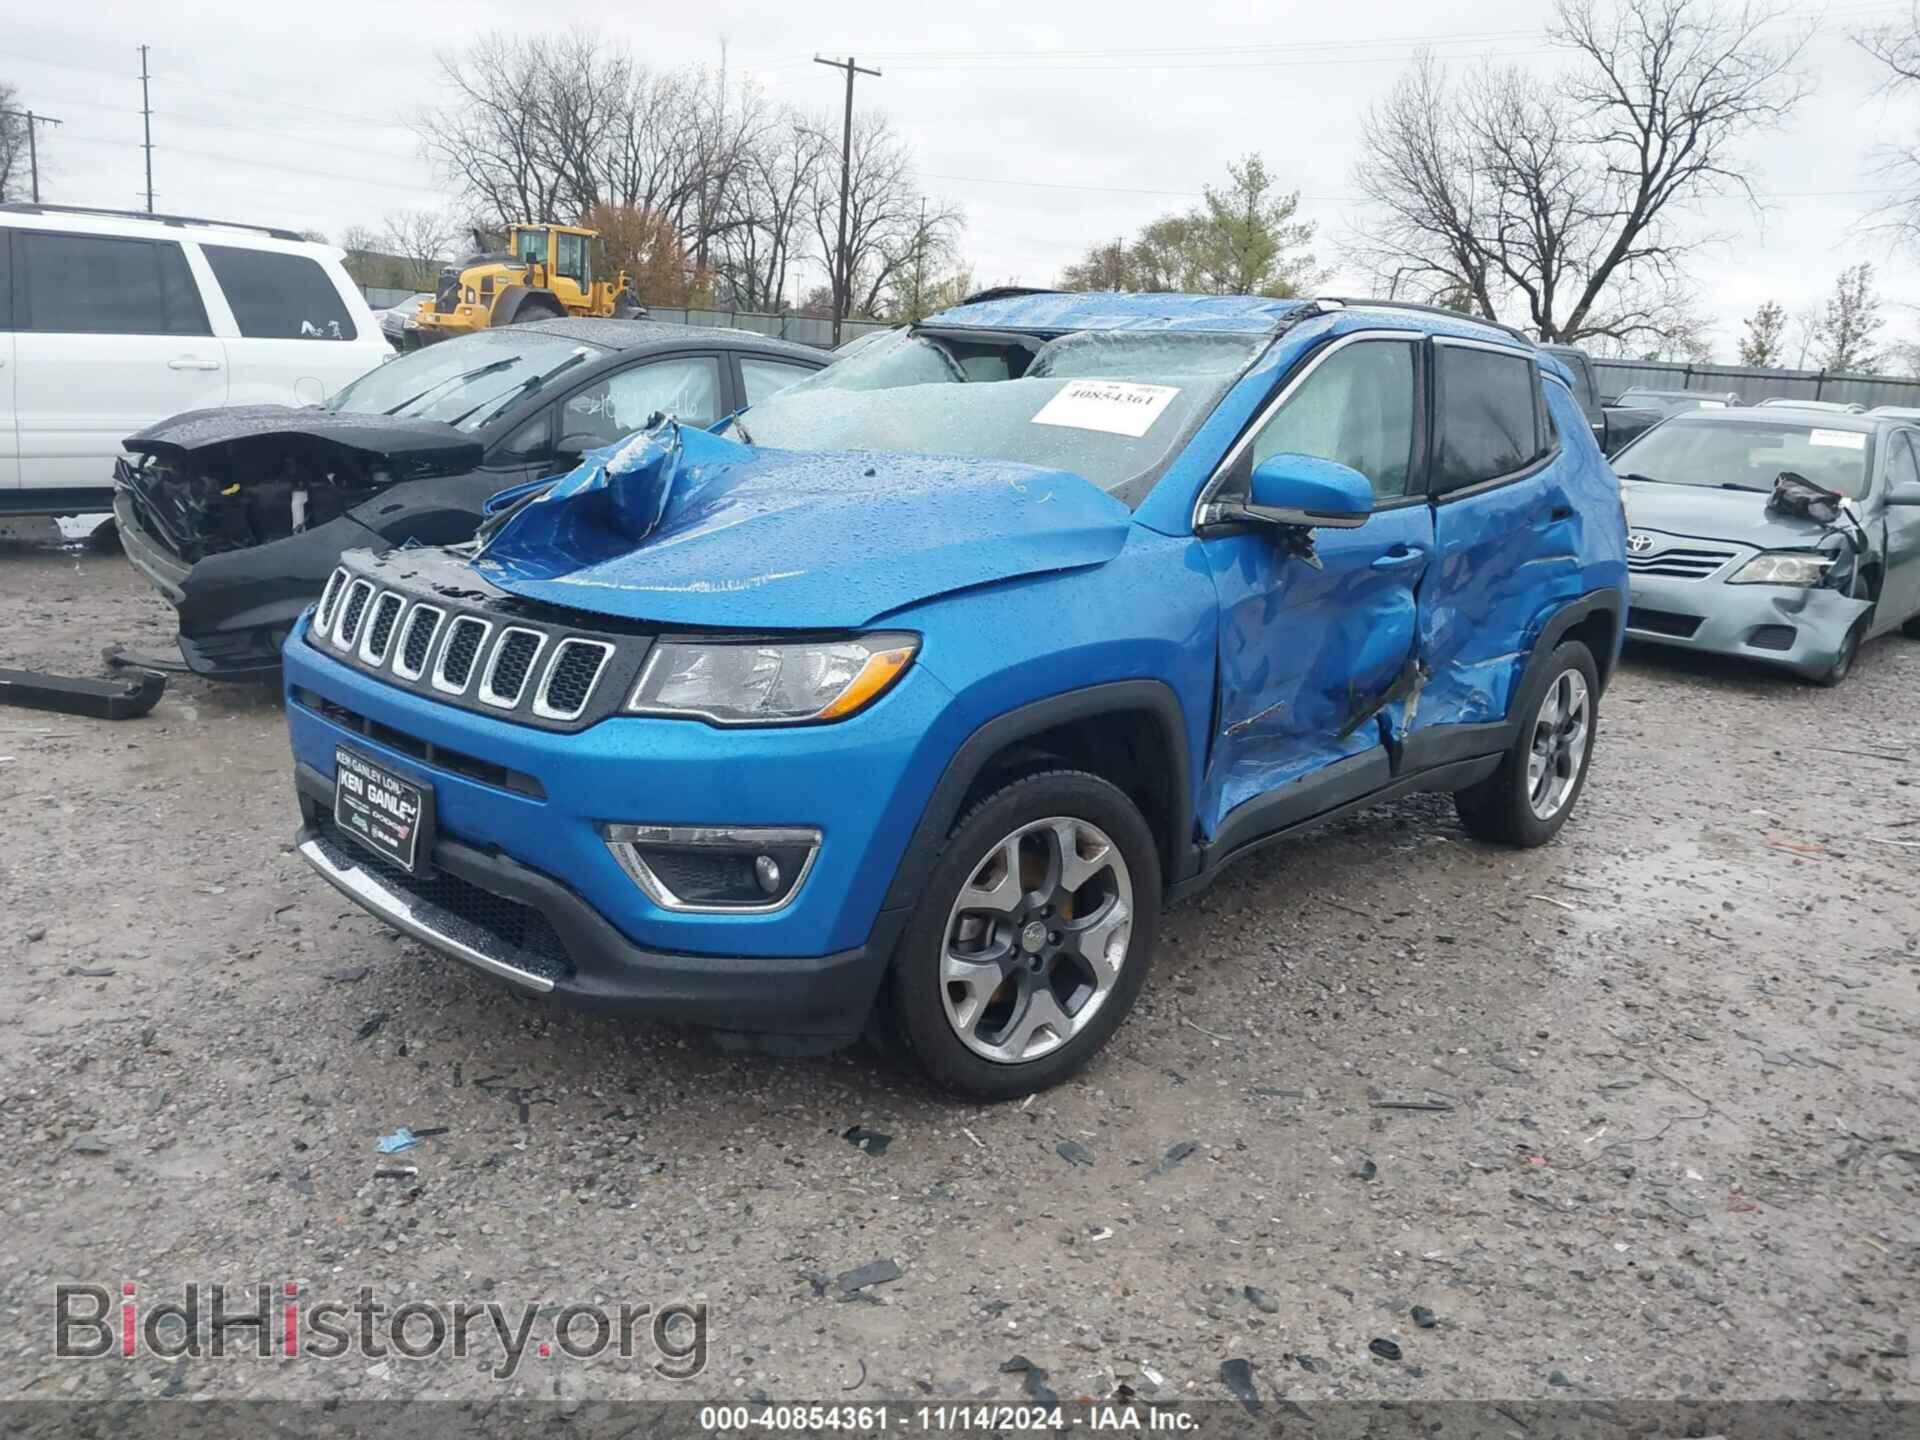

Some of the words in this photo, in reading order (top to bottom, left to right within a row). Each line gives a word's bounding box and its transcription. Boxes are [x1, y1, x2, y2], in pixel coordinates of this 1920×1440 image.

[1071, 389, 1154, 406] 40854361
[341, 769, 363, 796] KEN
[367, 784, 417, 823] GANLEY
